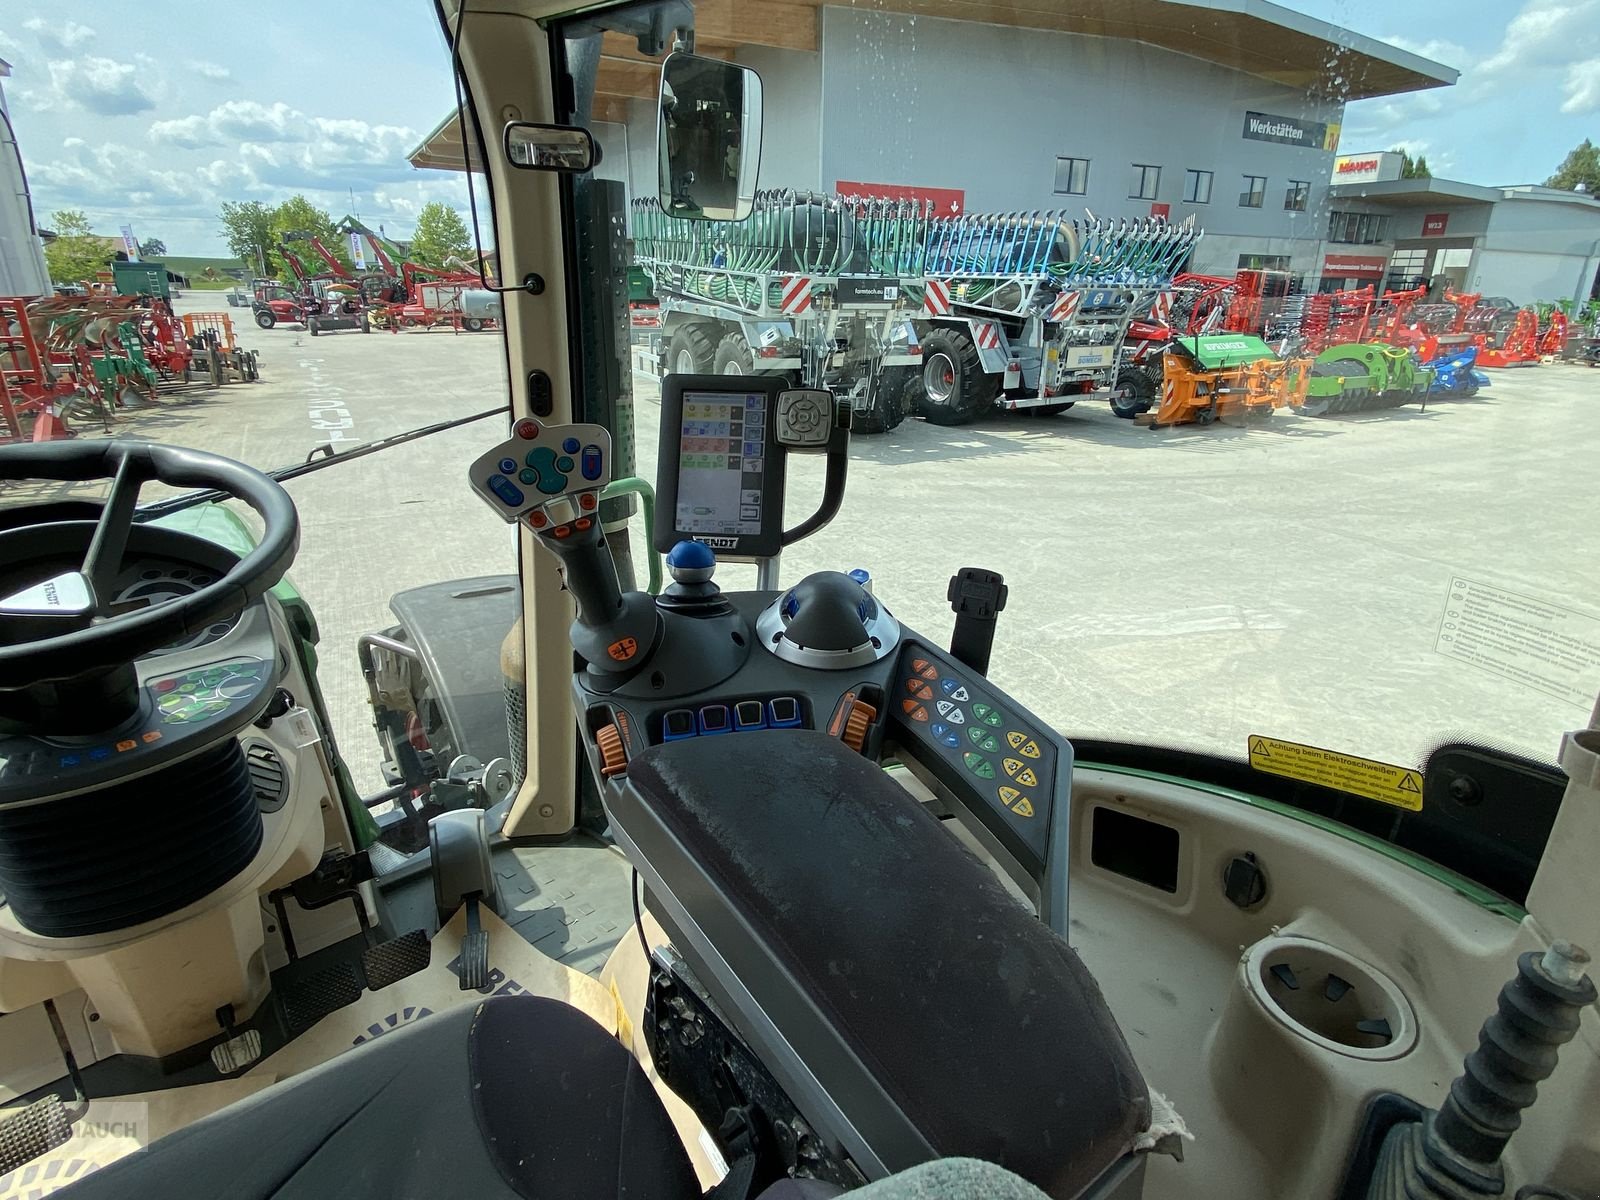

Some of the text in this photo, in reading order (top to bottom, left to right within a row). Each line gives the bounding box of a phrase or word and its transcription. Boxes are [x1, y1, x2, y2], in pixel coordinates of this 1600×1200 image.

[1250, 118, 1303, 140] Werkstätten
[1338, 159, 1378, 173] MAUCH
[854, 287, 884, 295] farmtech.eu
[43, 581, 61, 606] FENDT
[1268, 741, 1397, 777] Achtung beim Elektroschweißen
